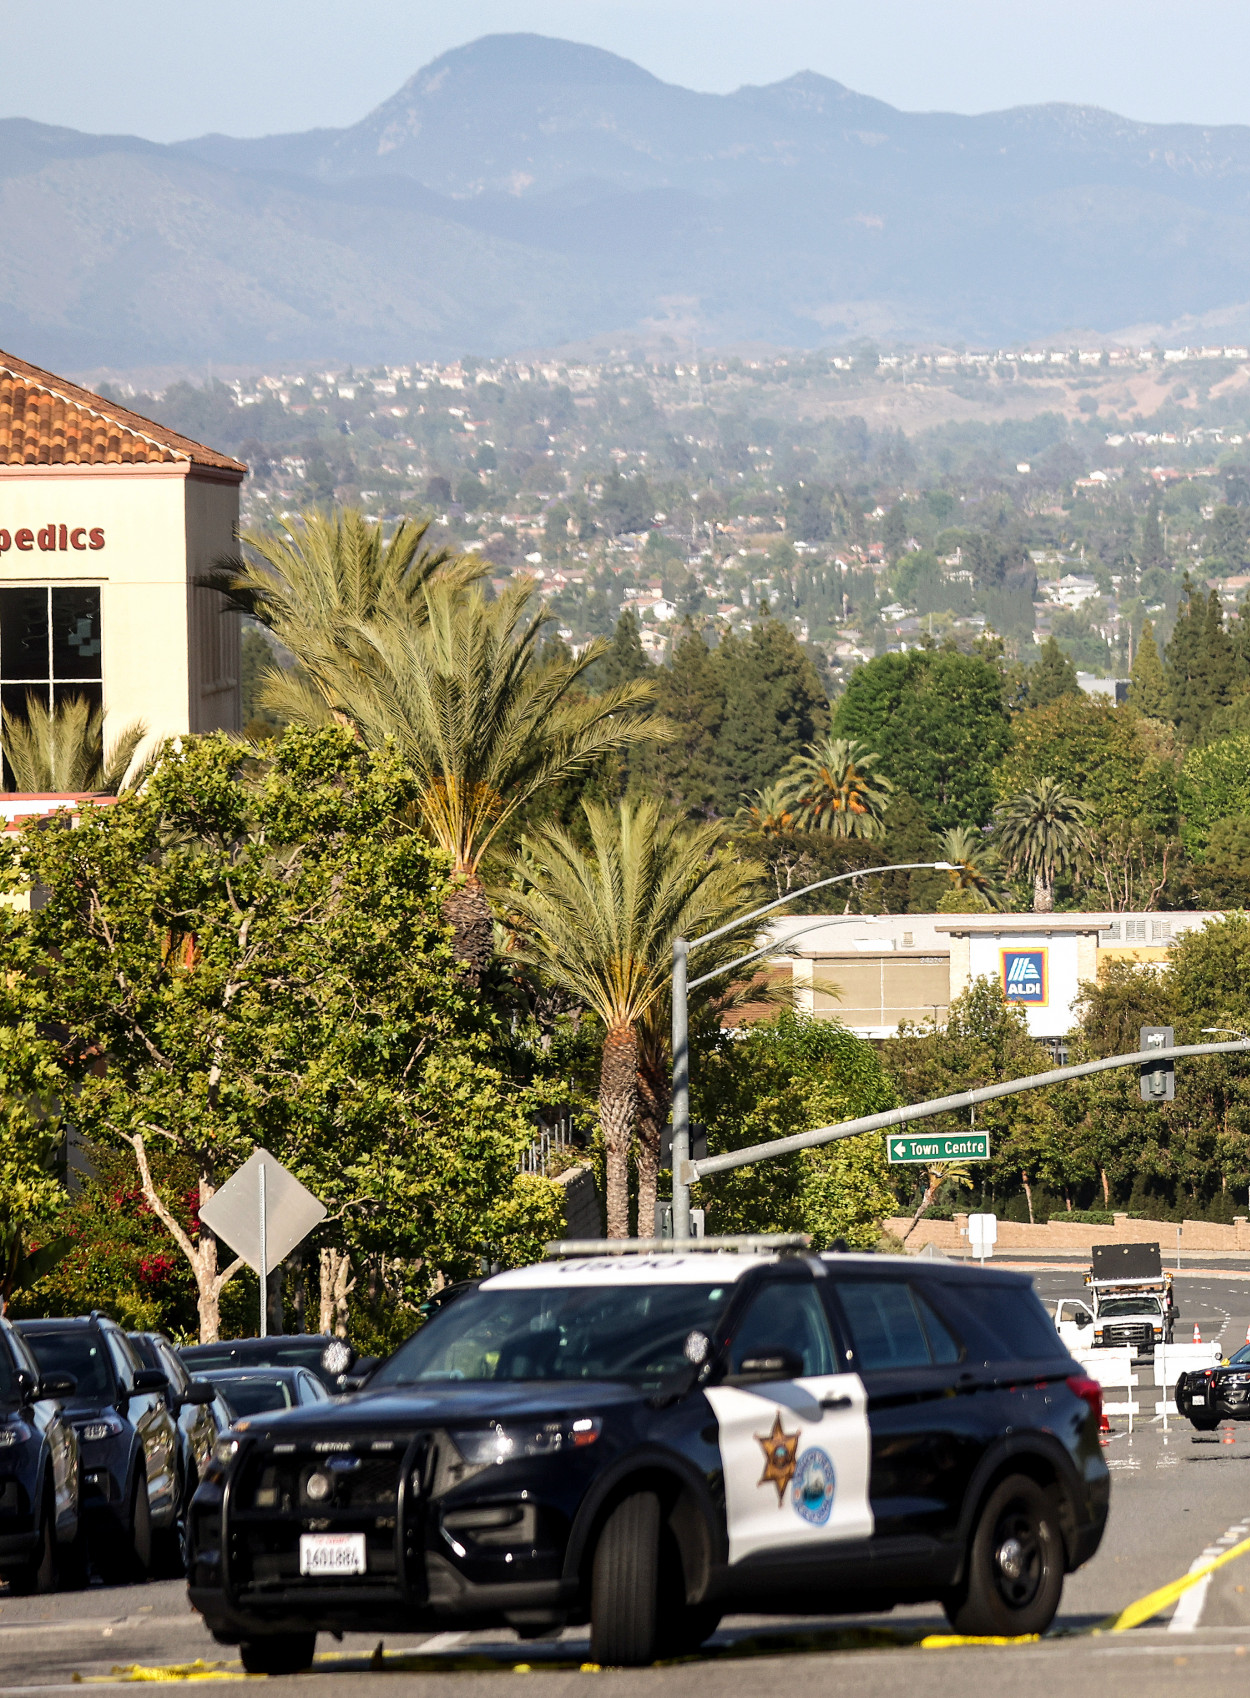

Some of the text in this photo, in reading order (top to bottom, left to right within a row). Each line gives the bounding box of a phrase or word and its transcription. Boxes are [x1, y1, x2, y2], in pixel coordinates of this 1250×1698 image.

[0, 524, 105, 557] pedics
[1007, 983, 1041, 995] ALDI
[909, 1140, 985, 1156] Town Centre
